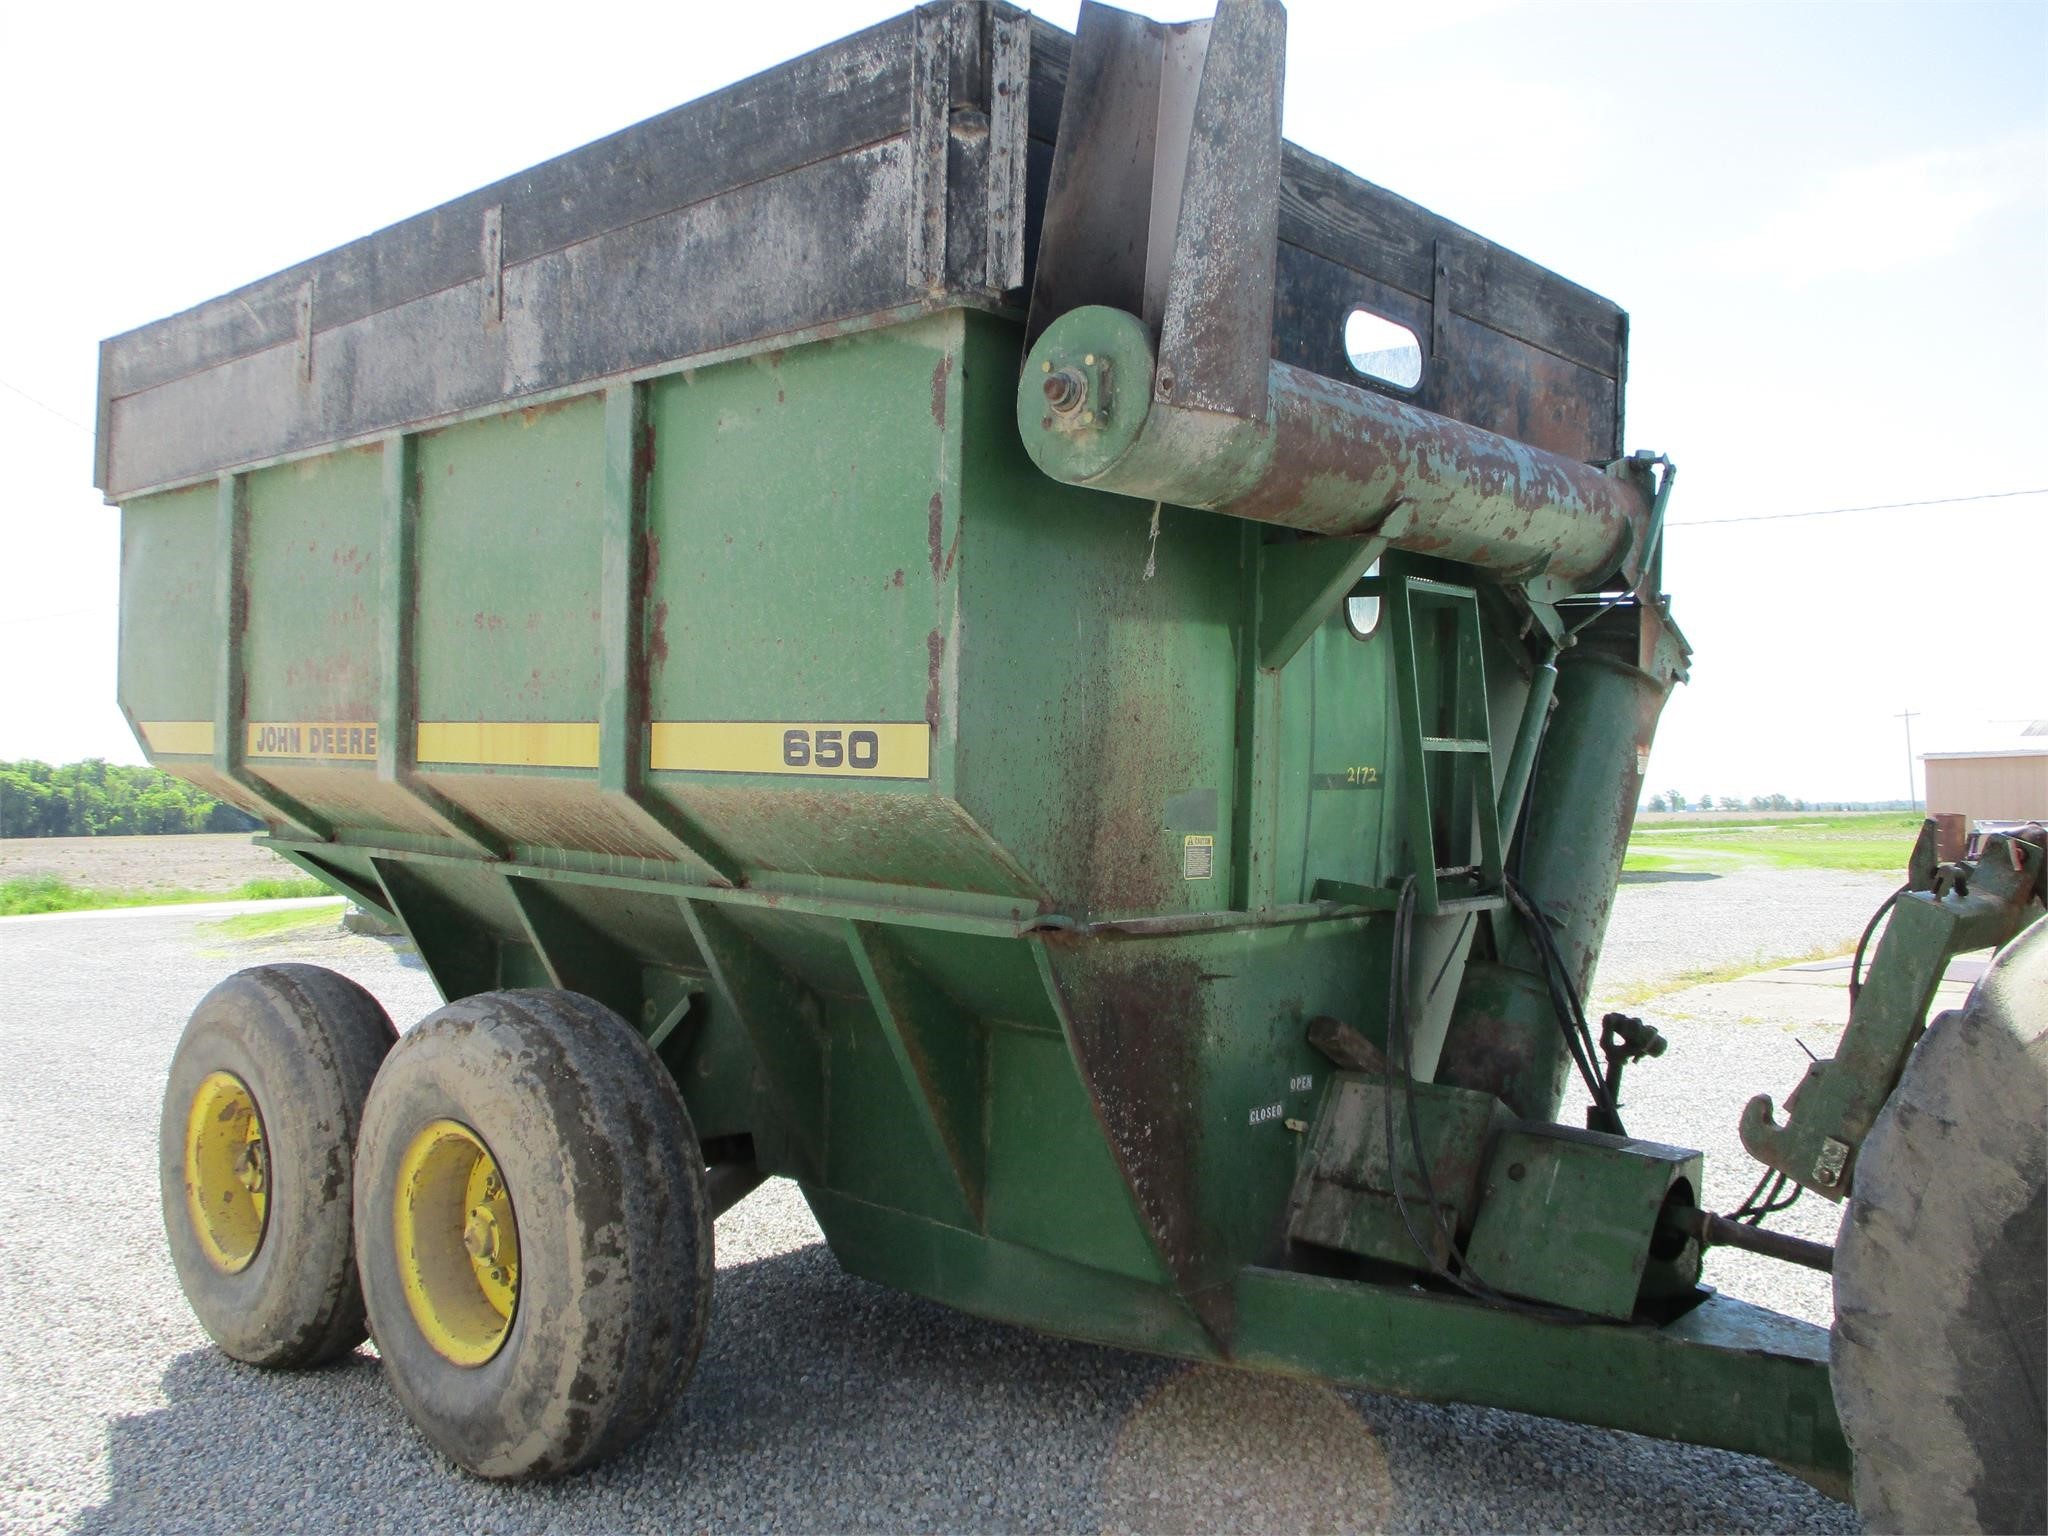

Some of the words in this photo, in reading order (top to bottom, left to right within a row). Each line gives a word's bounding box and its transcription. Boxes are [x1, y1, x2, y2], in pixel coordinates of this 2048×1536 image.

[257, 727, 300, 752] JOHN
[309, 727, 377, 755] DEERE
[783, 729, 879, 769] 650
[1346, 766, 1377, 785] 2172
[1290, 1075, 1312, 1090] OPEN
[1250, 1105, 1282, 1122] CLOSED
